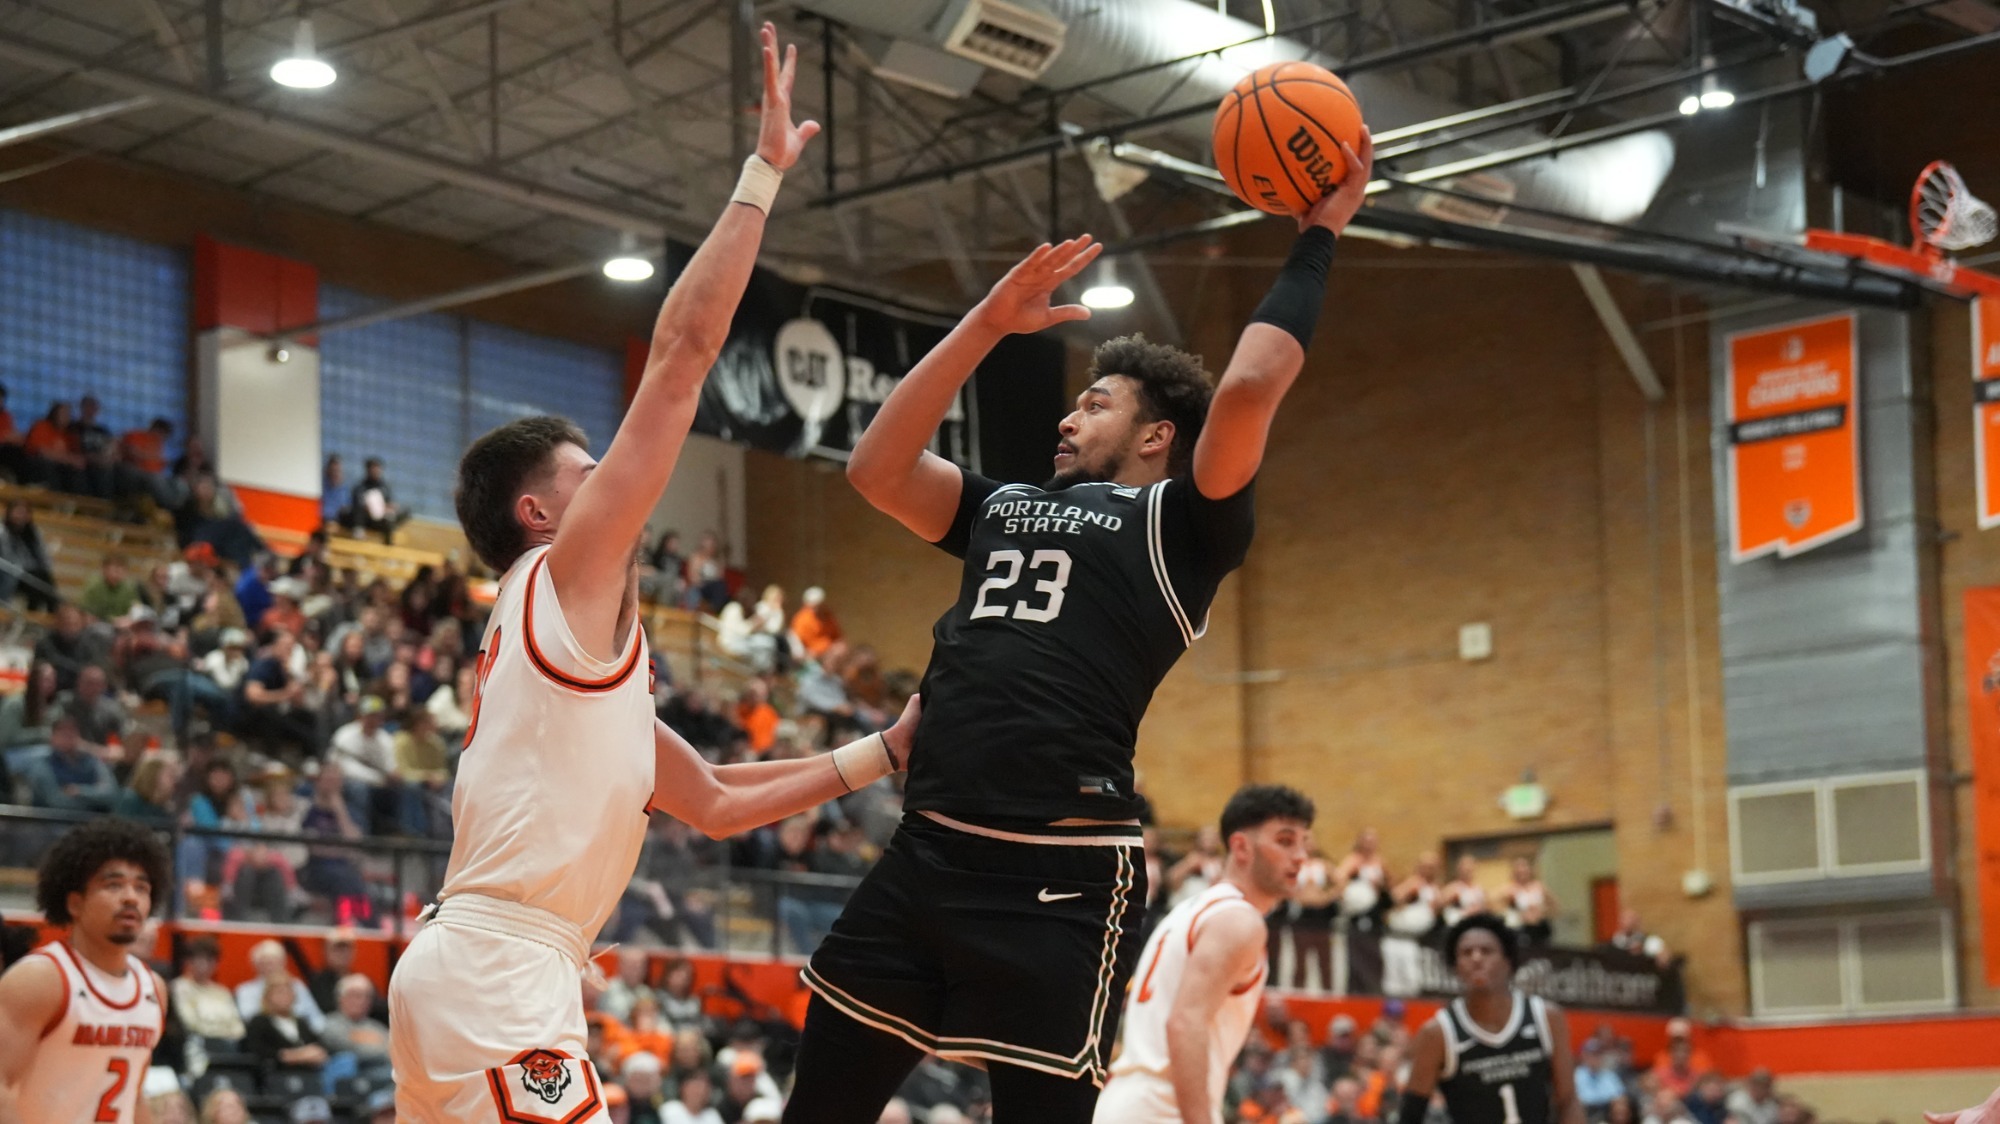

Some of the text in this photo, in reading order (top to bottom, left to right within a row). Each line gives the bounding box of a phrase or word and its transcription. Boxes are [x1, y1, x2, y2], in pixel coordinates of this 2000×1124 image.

[1286, 125, 1338, 198] Wilso
[985, 500, 1122, 532] PORTLAND
[1004, 517, 1083, 535] STATE
[969, 549, 1073, 624] 23
[94, 1057, 130, 1123] 2
[1498, 1083, 1522, 1124] 1
